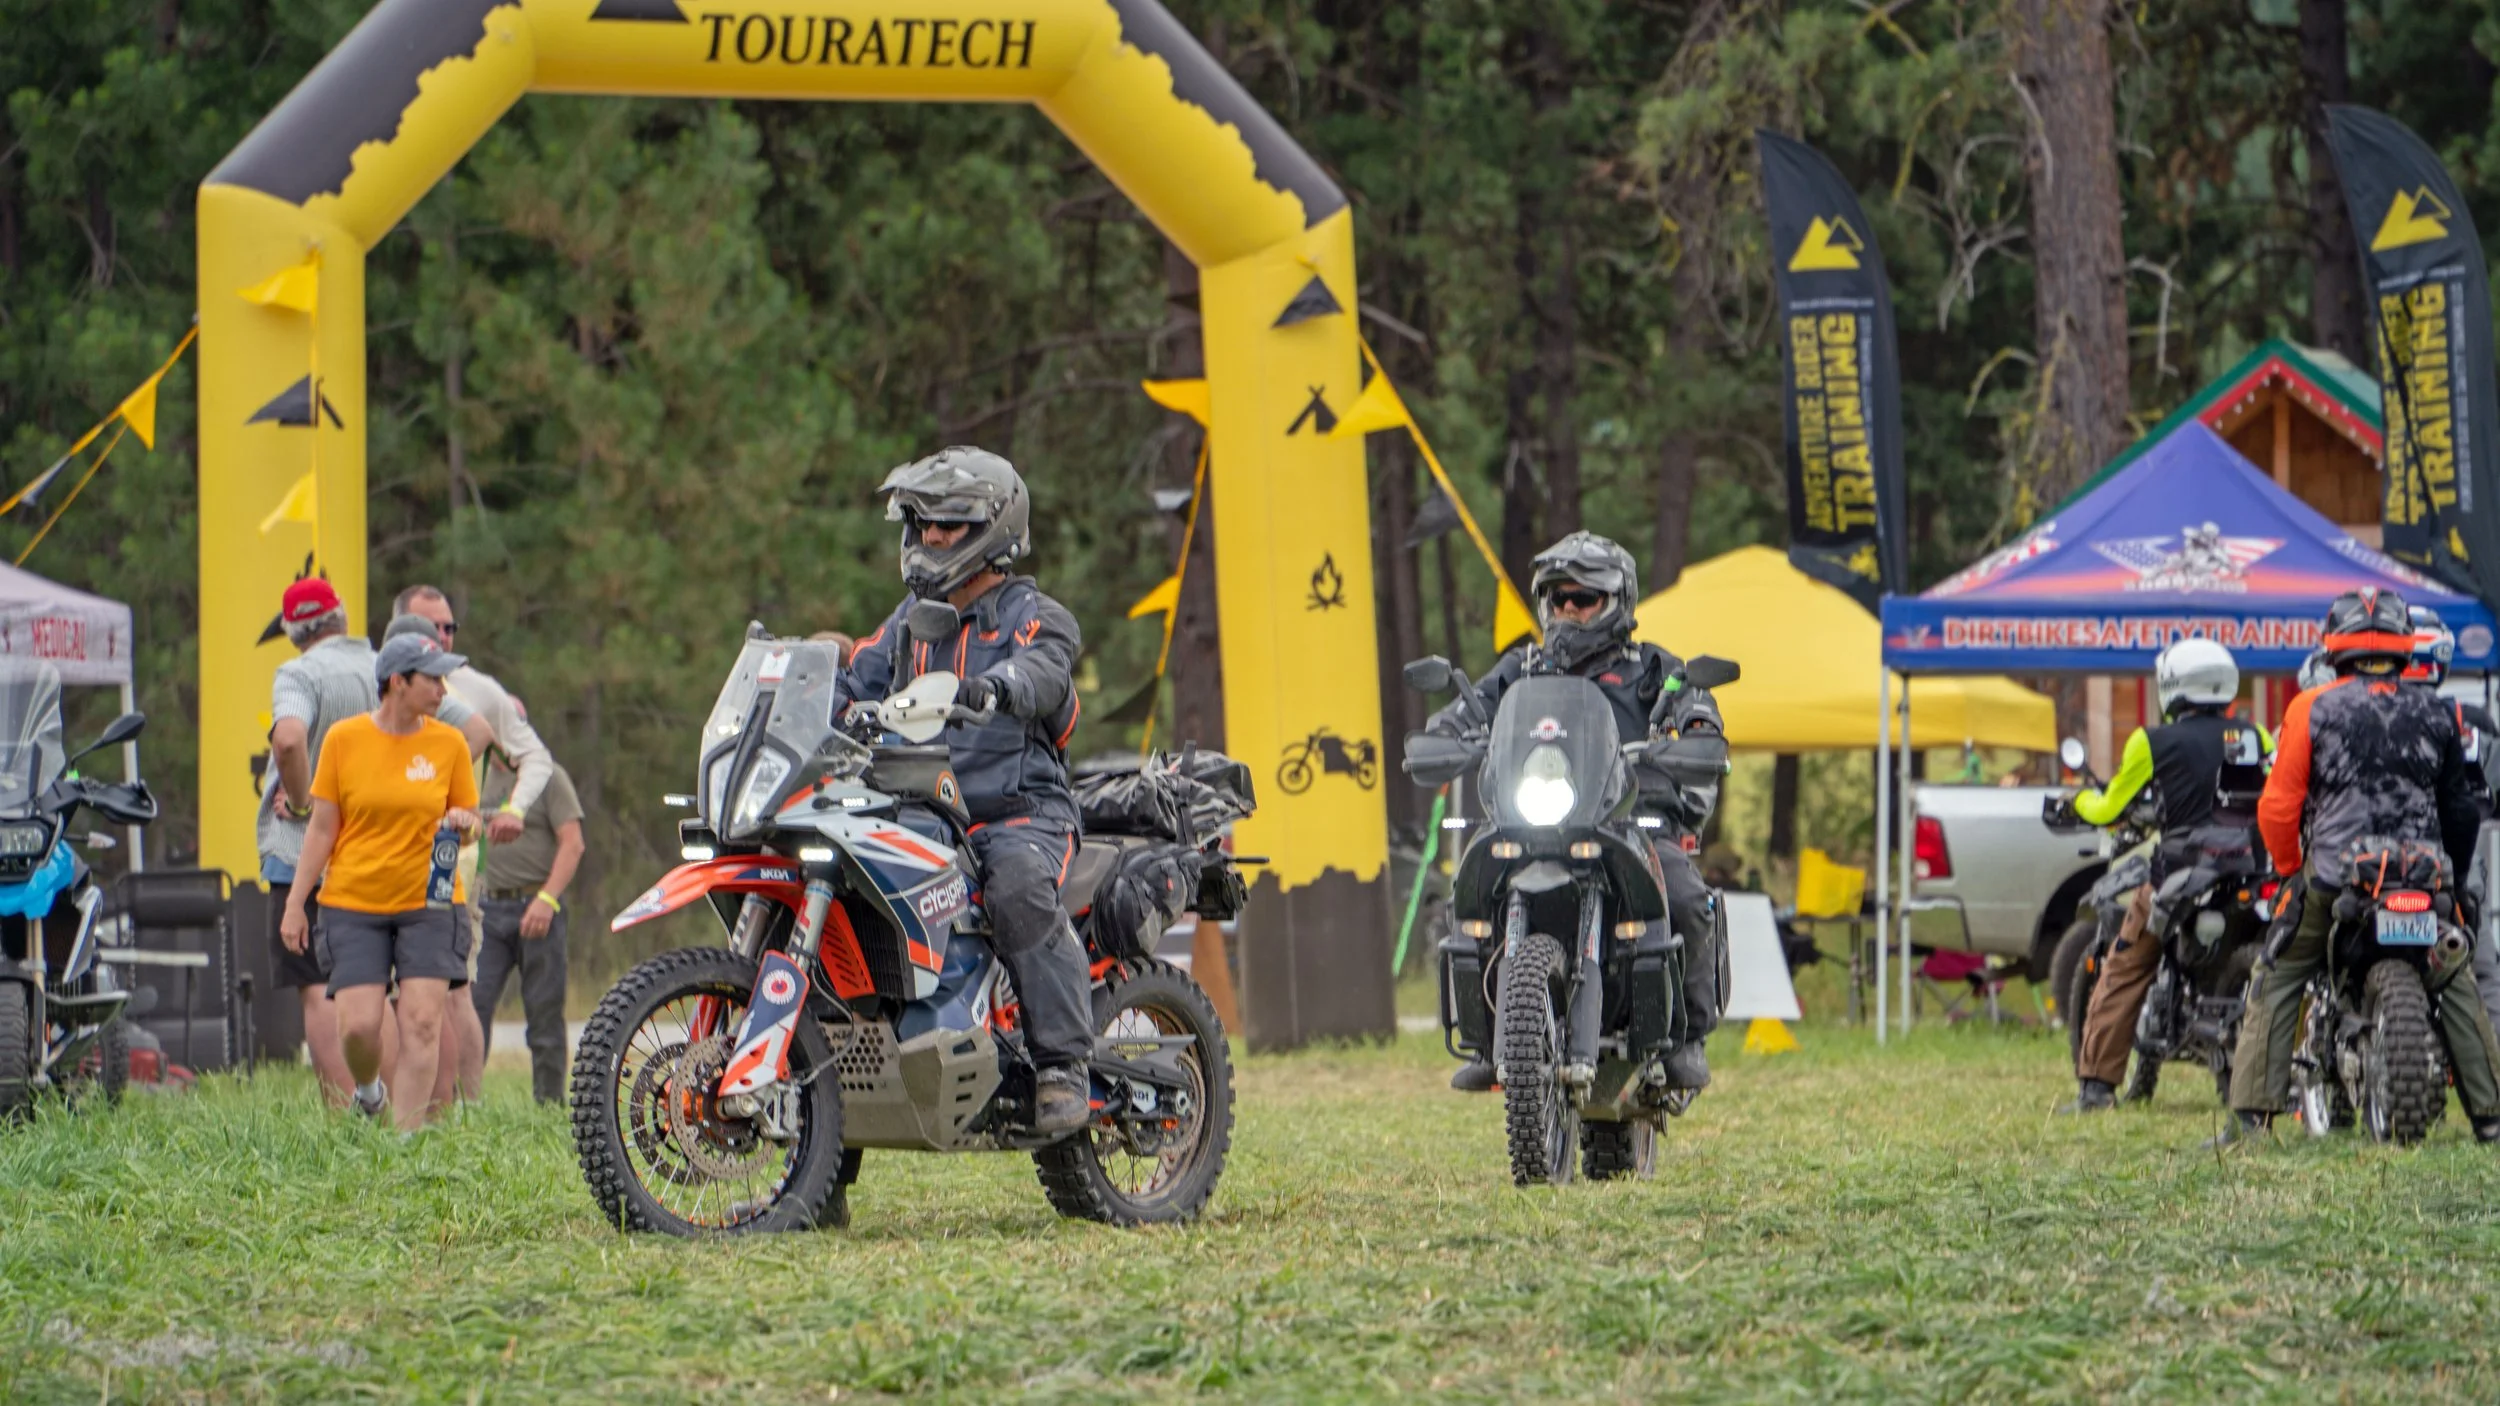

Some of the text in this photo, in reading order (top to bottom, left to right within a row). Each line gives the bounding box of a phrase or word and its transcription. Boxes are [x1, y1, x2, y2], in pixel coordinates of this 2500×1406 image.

[701, 13, 1037, 69] TOURATECH
[1790, 314, 1834, 532] ADVENTURE RIDER
[1819, 313, 1877, 533] TRAINING
[2407, 282, 2457, 514] TRAINING
[31, 616, 87, 661] MEDICAL
[1942, 617, 2325, 650] DIRTBIKESAFETYTRAININ
